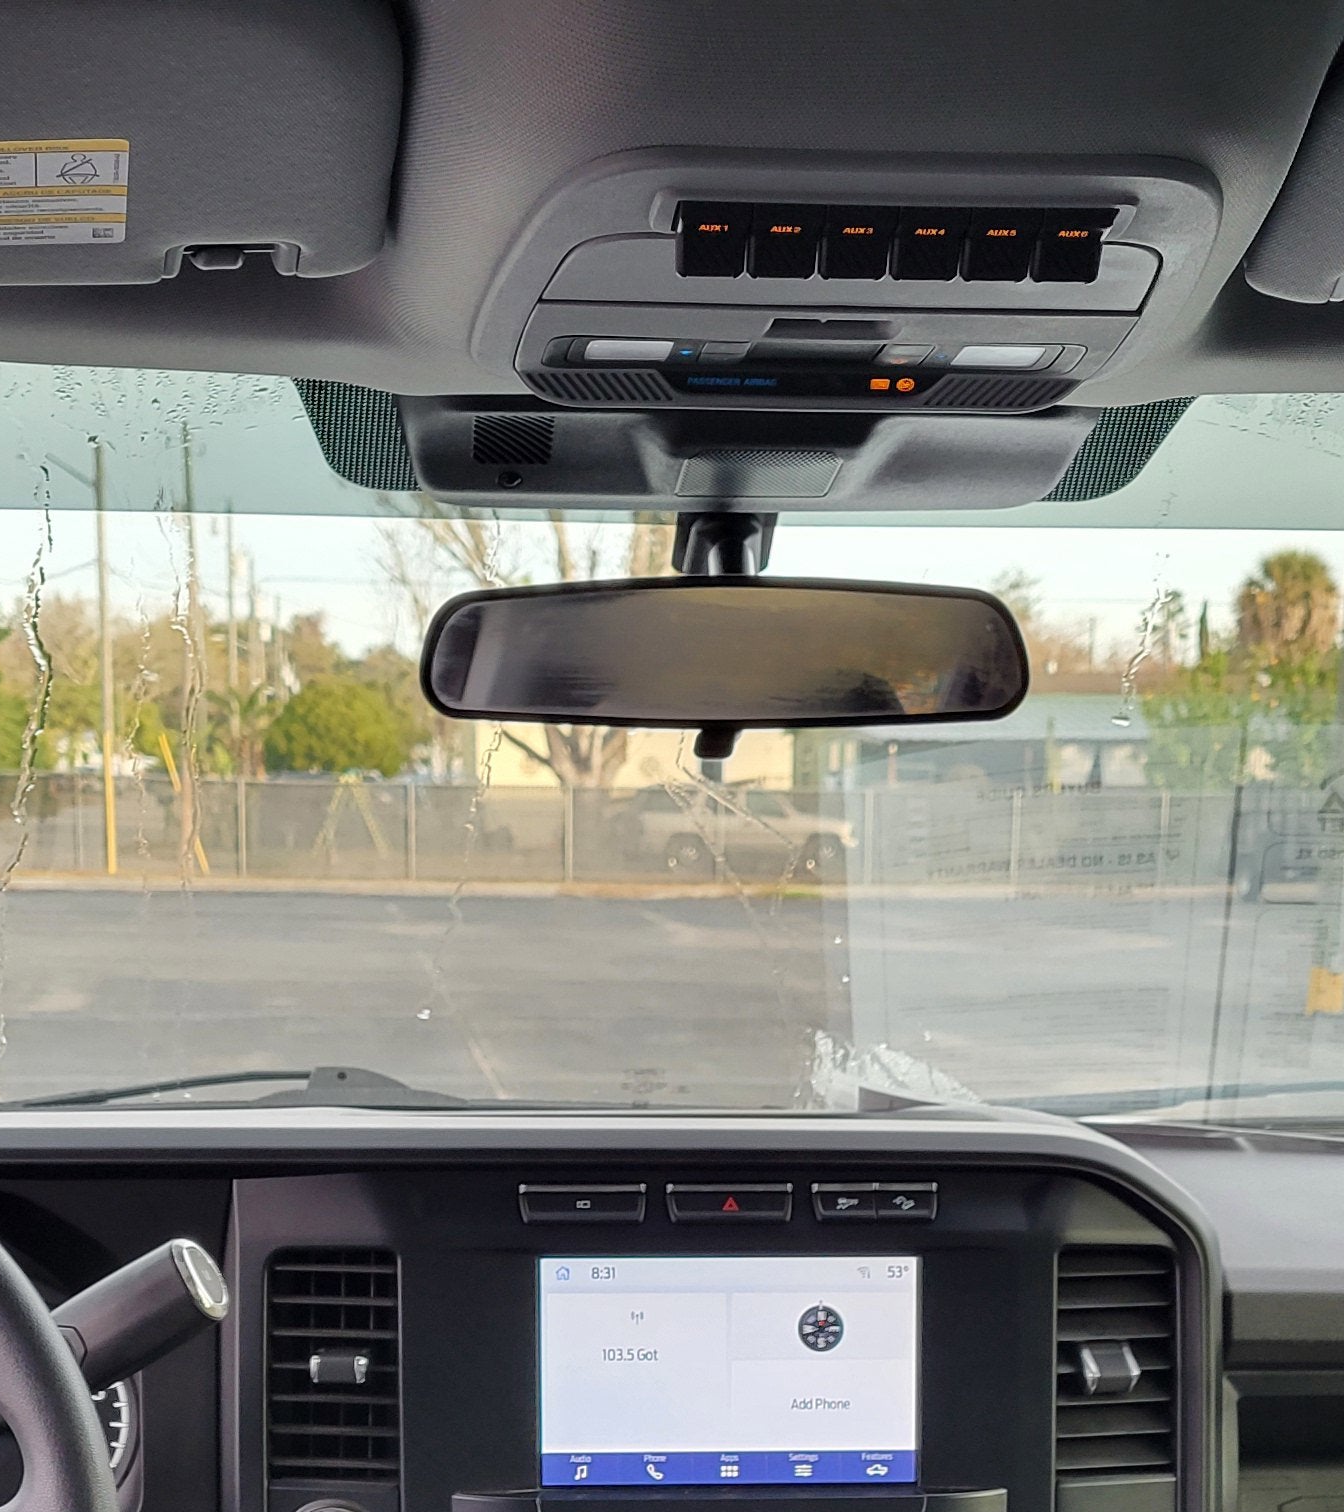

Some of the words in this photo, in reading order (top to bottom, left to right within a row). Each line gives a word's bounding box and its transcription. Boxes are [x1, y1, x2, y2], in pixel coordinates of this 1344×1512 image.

[590, 1266, 617, 1281] 8:31
[886, 1265, 910, 1279] 53°
[601, 1347, 635, 1362] 103.5
[635, 1347, 659, 1362] Got
[790, 1397, 813, 1411] Add
[815, 1397, 851, 1411] Phone
[569, 1454, 592, 1464] Audio
[643, 1453, 667, 1464] Phone
[720, 1453, 740, 1464] Apps
[788, 1452, 819, 1463] Settings
[861, 1452, 894, 1462] Features
